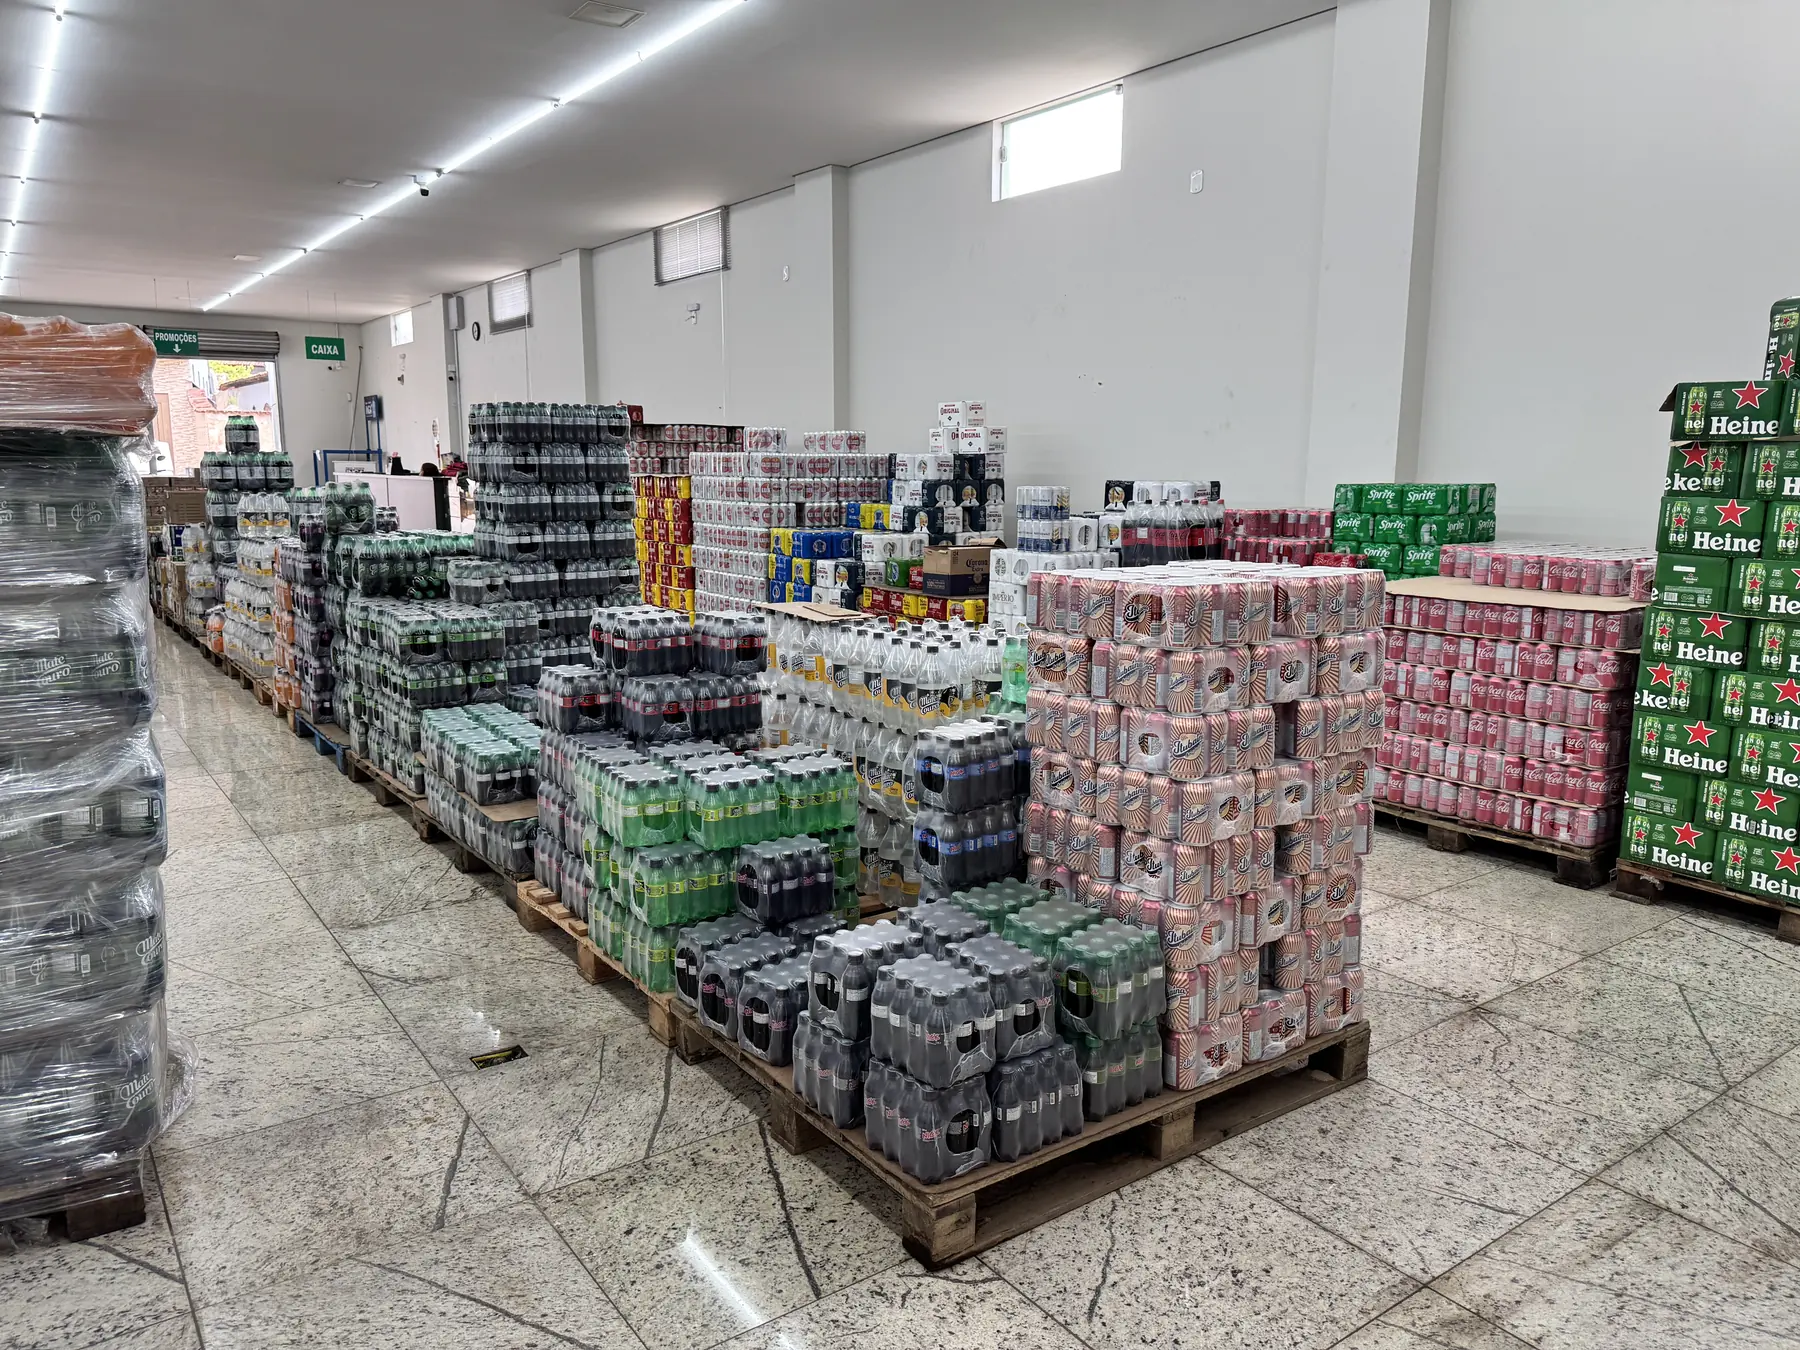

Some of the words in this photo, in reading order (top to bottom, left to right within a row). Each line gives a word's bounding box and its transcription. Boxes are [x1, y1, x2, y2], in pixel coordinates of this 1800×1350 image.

[155, 332, 197, 344] PROMOÇÕES
[311, 344, 340, 355] CAIXA
[940, 407, 959, 415] ORIGINAL
[1709, 416, 1779, 435] Heine
[961, 432, 981, 440] ORIGINAL
[1664, 472, 1703, 491] eke
[1367, 489, 1396, 503] Sprite
[1406, 490, 1436, 503] Sprite
[1336, 518, 1360, 528] Sprite
[1379, 520, 1406, 531] Sprite
[1447, 521, 1465, 531] Sprite
[1478, 519, 1496, 530] Sprite
[1692, 531, 1761, 552] Heine
[1364, 548, 1391, 559] Sprite
[1406, 550, 1435, 561] Sprite
[966, 558, 988, 568] Corona
[1524, 564, 1540, 575] Cola
[1676, 641, 1743, 665] Heine
[1634, 690, 1671, 709] eke
[1663, 747, 1728, 773] Heine
[1652, 846, 1713, 875] Heine
